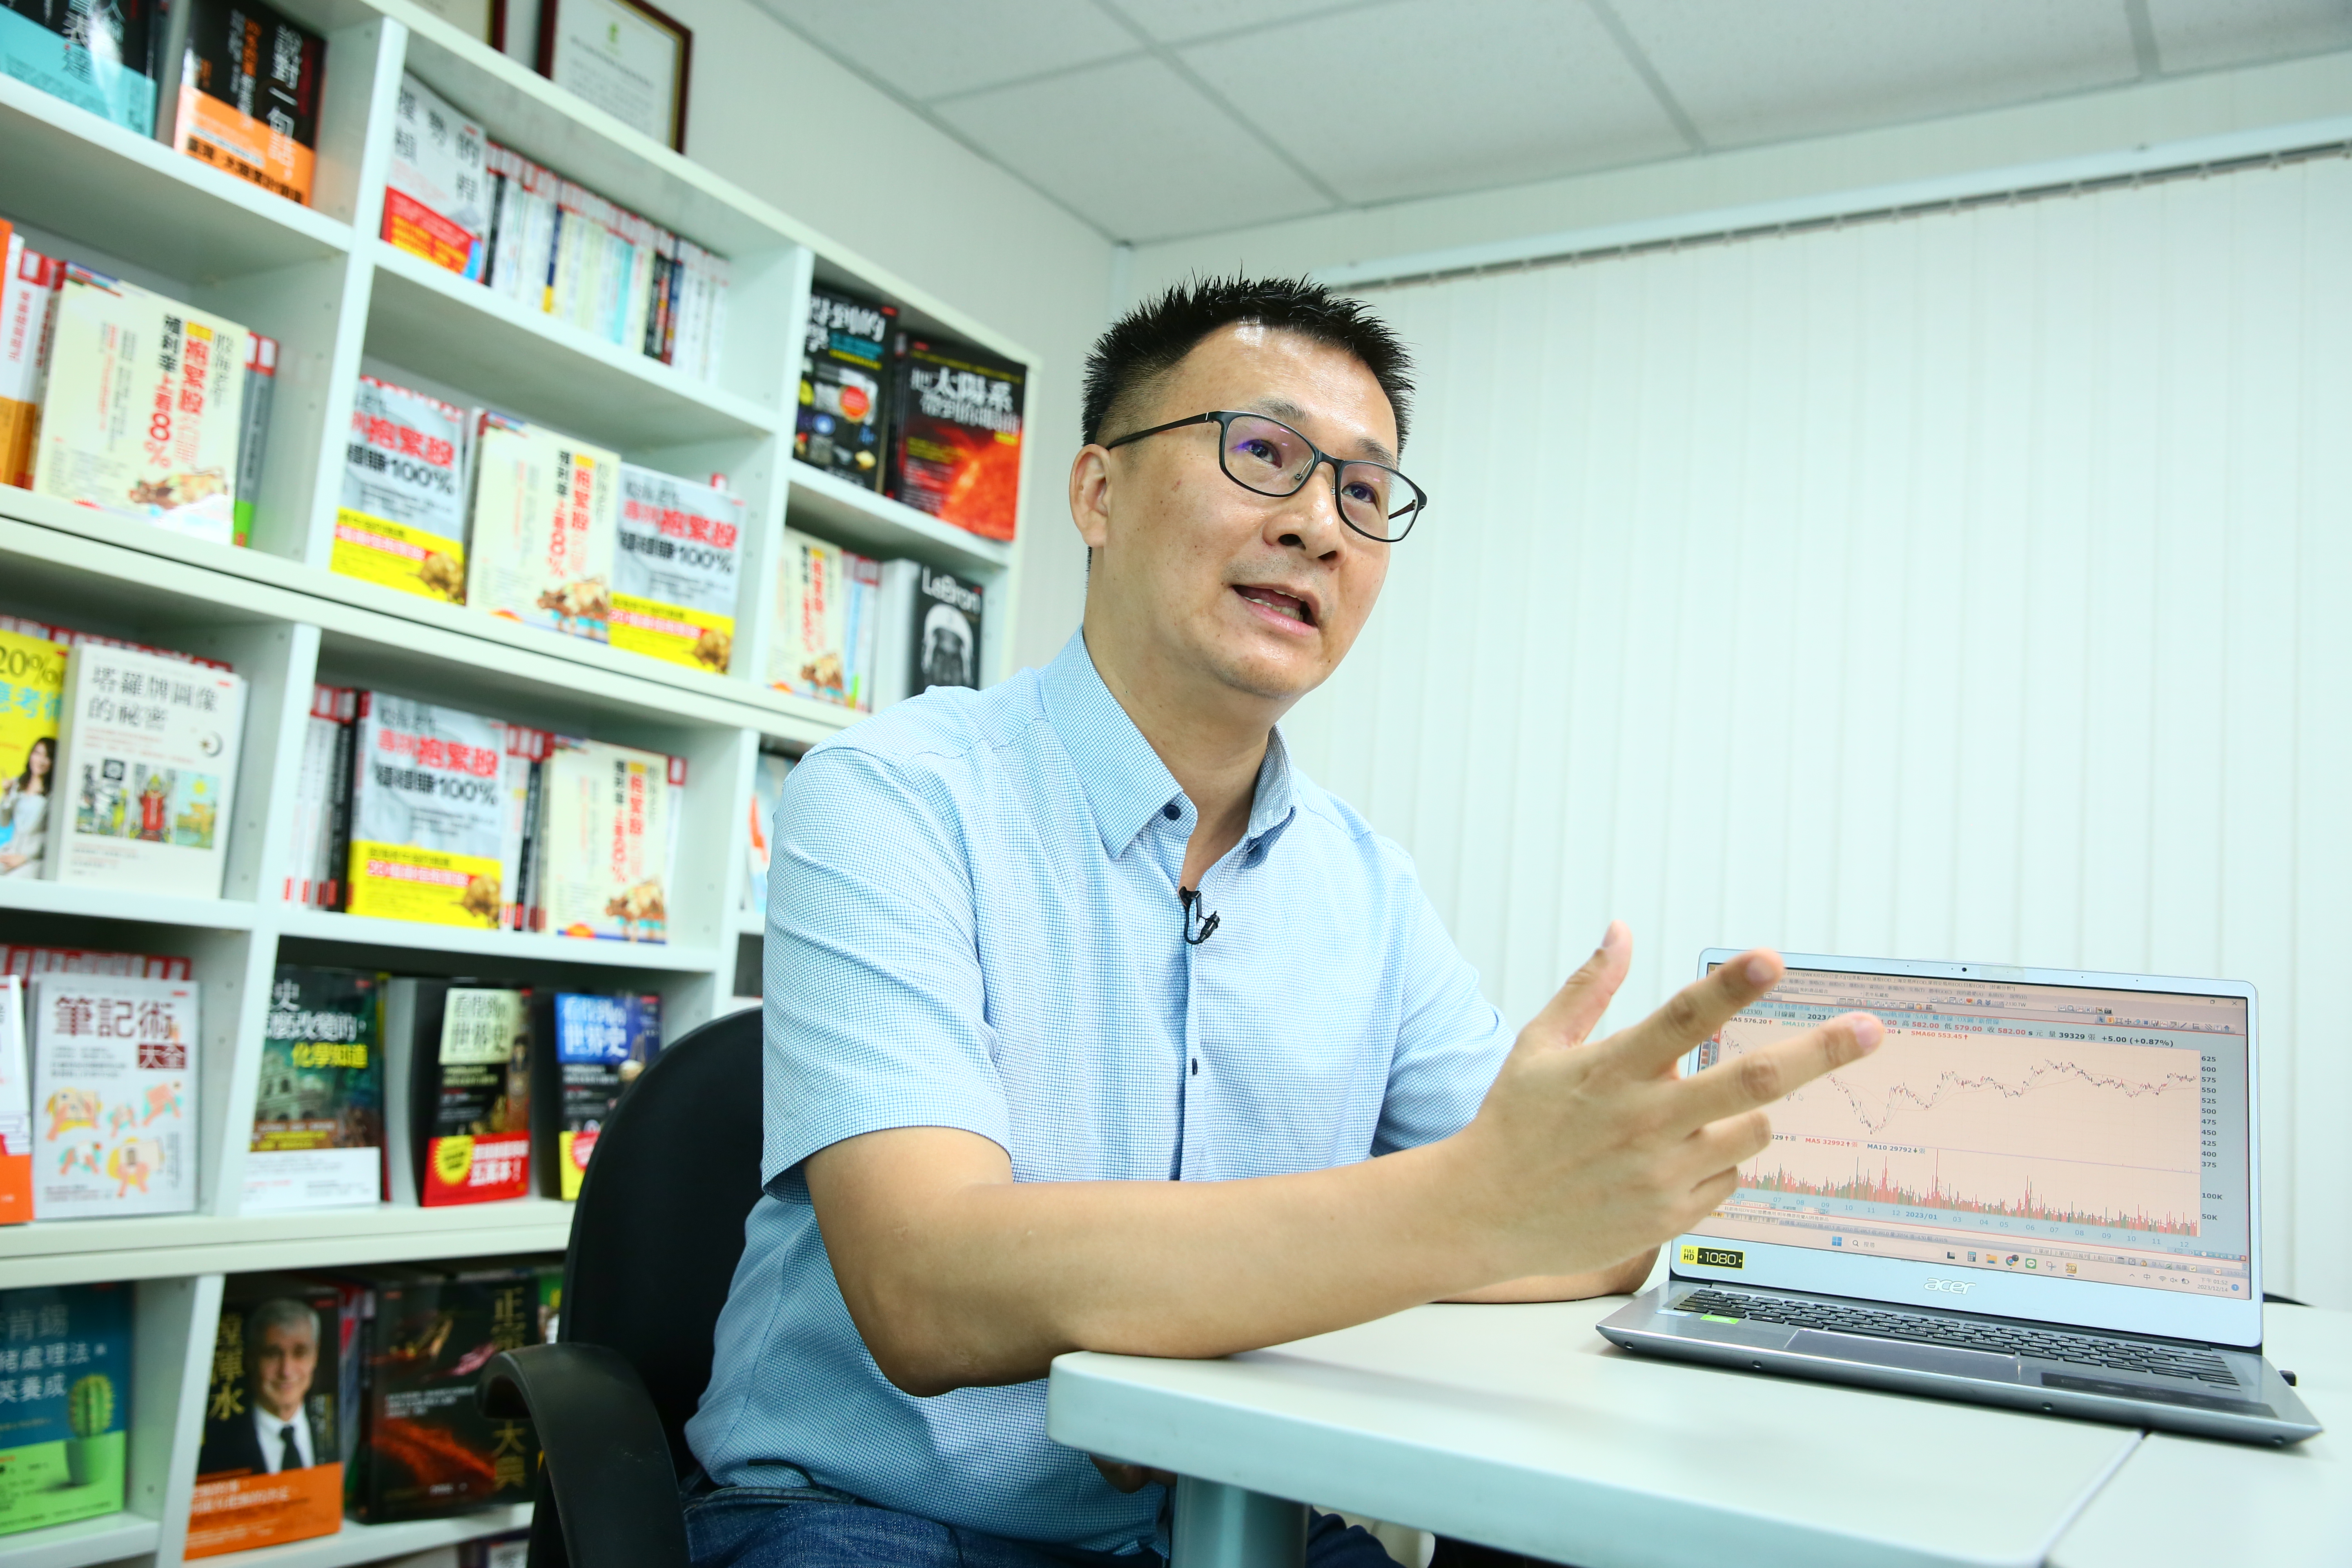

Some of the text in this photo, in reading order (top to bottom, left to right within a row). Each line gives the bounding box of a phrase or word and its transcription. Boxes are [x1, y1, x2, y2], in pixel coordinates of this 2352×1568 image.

[922, 566, 981, 615] LeBron
[91, 665, 218, 713] 塔羅牌圖像
[270, 978, 300, 1011] 史
[54, 996, 176, 1039] 筆記術
[1774, 1010, 1795, 1018] 日線圖
[2059, 1032, 2085, 1040] 39329
[2088, 1033, 2096, 1041] 張
[2101, 1035, 2127, 1043] +5.00
[2129, 1037, 2174, 1048] (+0.87%)
[450, 1022, 508, 1054] 世界史
[564, 1026, 628, 1058] 世界史
[139, 1045, 187, 1069] 大全
[292, 1042, 369, 1069] 化學知道
[1905, 1211, 1938, 1220] 2023/01
[1704, 1251, 1737, 1265] 1080
[1924, 1277, 1977, 1295] acer
[2197, 1284, 2228, 1292] 2023/12/14
[0, 1305, 69, 1341] 肯錫
